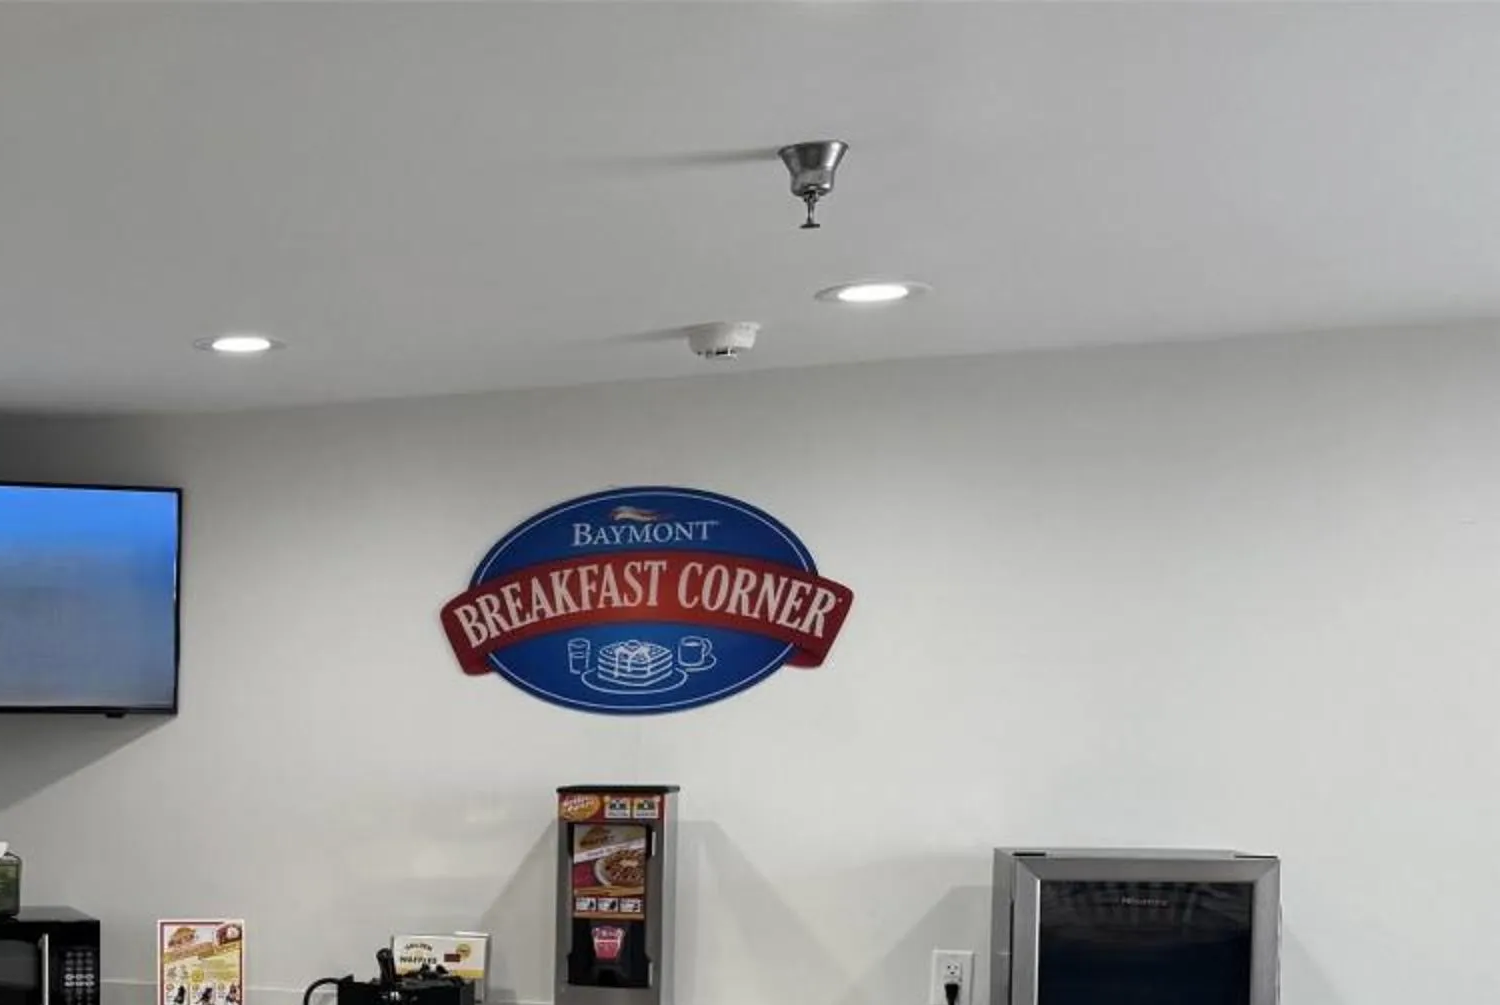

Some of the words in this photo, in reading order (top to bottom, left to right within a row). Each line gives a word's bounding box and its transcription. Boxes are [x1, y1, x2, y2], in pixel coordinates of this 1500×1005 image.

[572, 520, 715, 547] BAYMONT
[453, 560, 668, 649] BREAKFAST
[677, 561, 837, 639] CORNER
